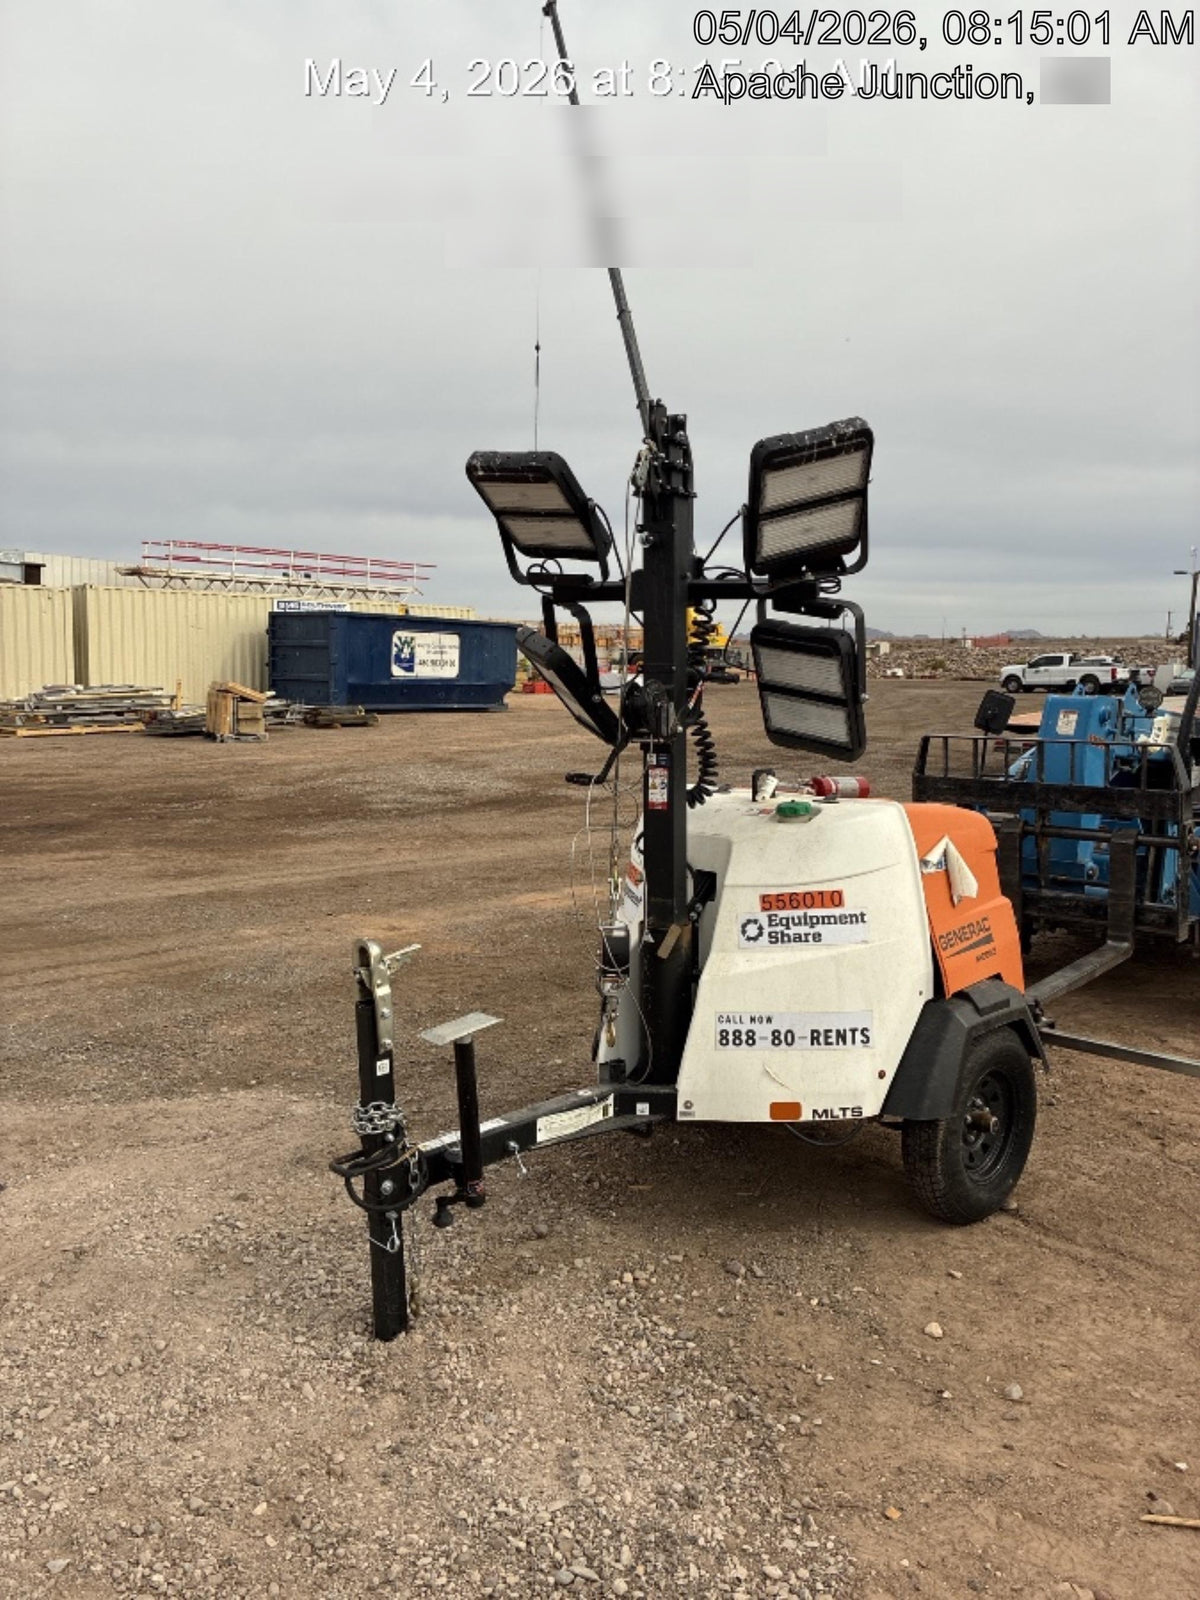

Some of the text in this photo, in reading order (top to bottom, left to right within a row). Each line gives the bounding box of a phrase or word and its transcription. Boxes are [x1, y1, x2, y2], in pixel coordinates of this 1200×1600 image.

[761, 889, 843, 911] 556010
[767, 911, 867, 930] Equipment
[767, 930, 823, 945] Share
[938, 916, 991, 951] GENERAC
[717, 1014, 774, 1025] CALL NOW
[718, 1027, 871, 1047] 888-80-RENTS
[811, 1106, 864, 1119] MLTS
